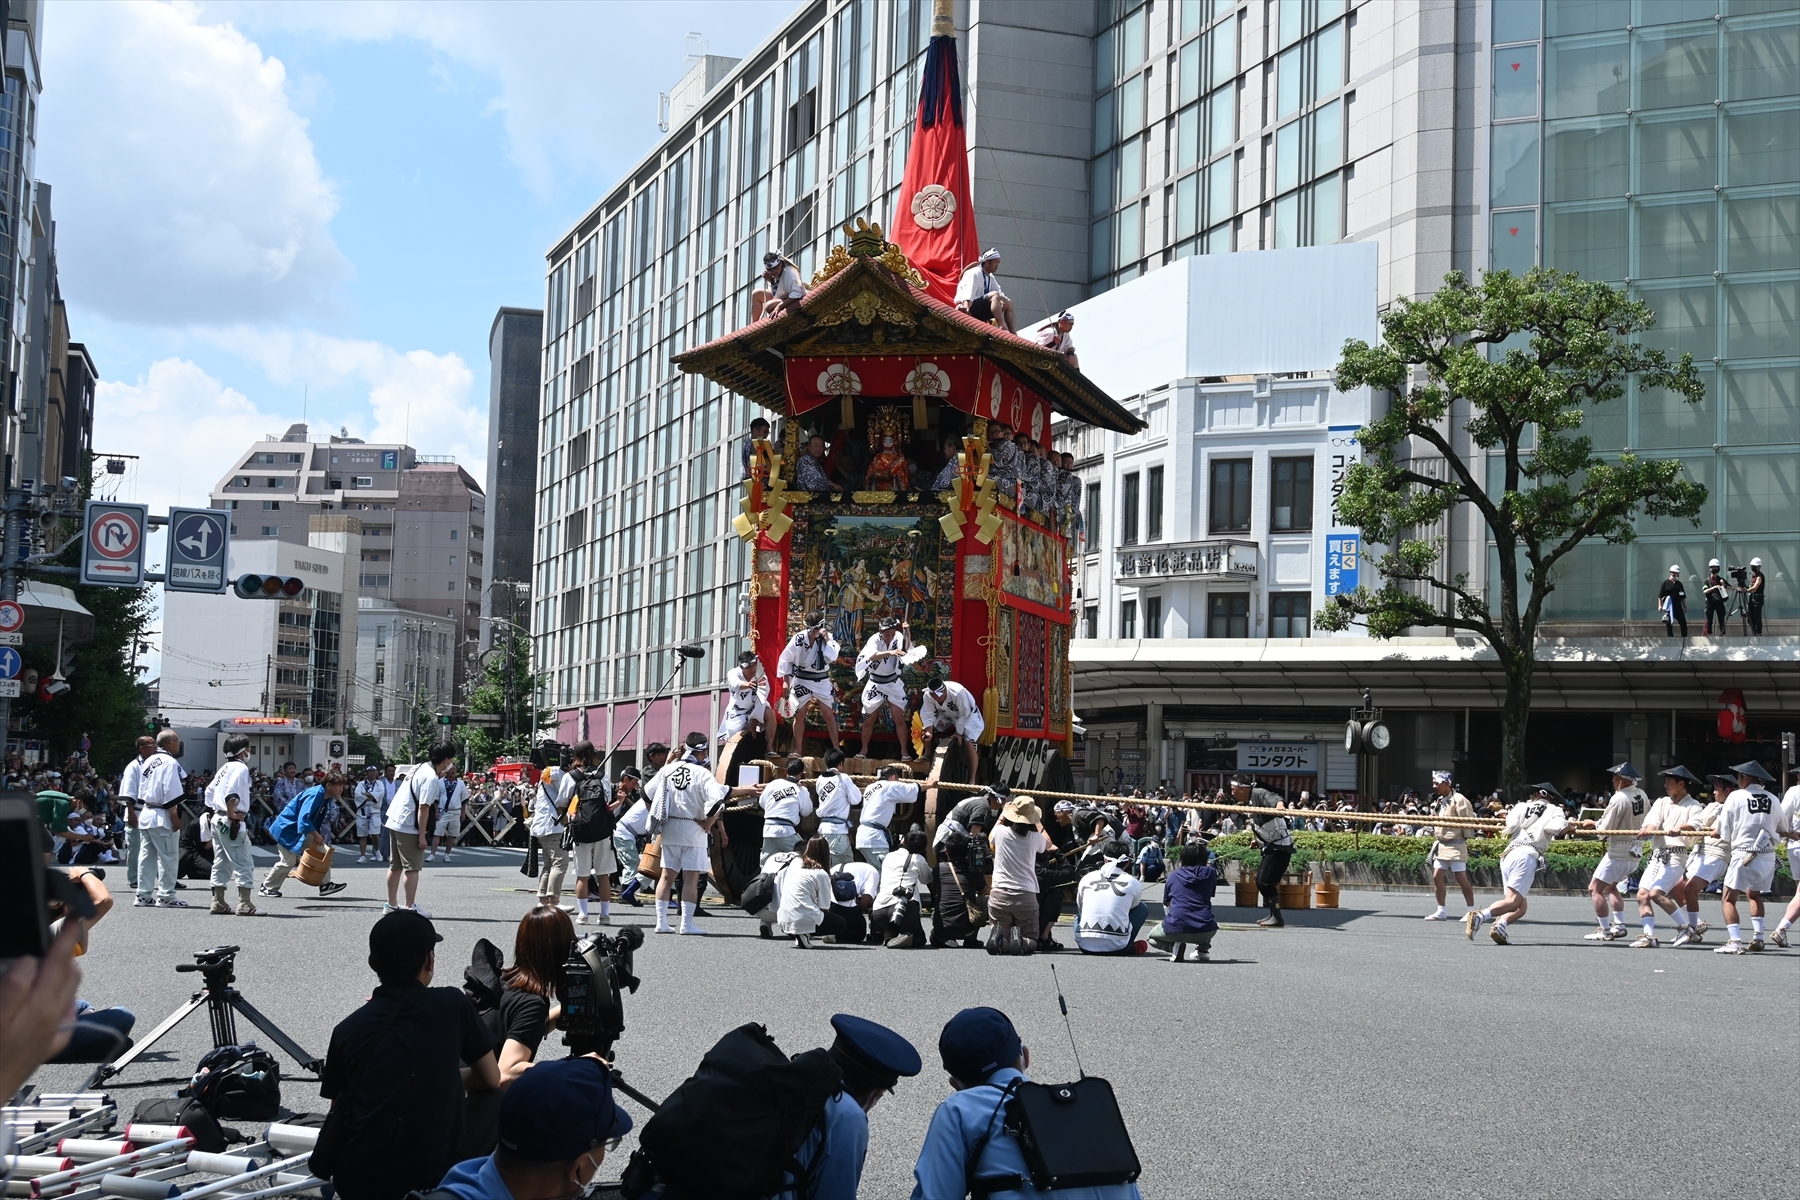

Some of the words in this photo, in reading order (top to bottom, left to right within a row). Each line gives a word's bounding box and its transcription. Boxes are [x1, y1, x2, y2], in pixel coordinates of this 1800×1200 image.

[1121, 549, 1221, 575] 池善化粧品店
[1328, 540, 1341, 594] 買えます
[1343, 541, 1354, 568] すぐ
[172, 567, 220, 580] 路線バスを除く
[1248, 755, 1308, 768] コンタクト
